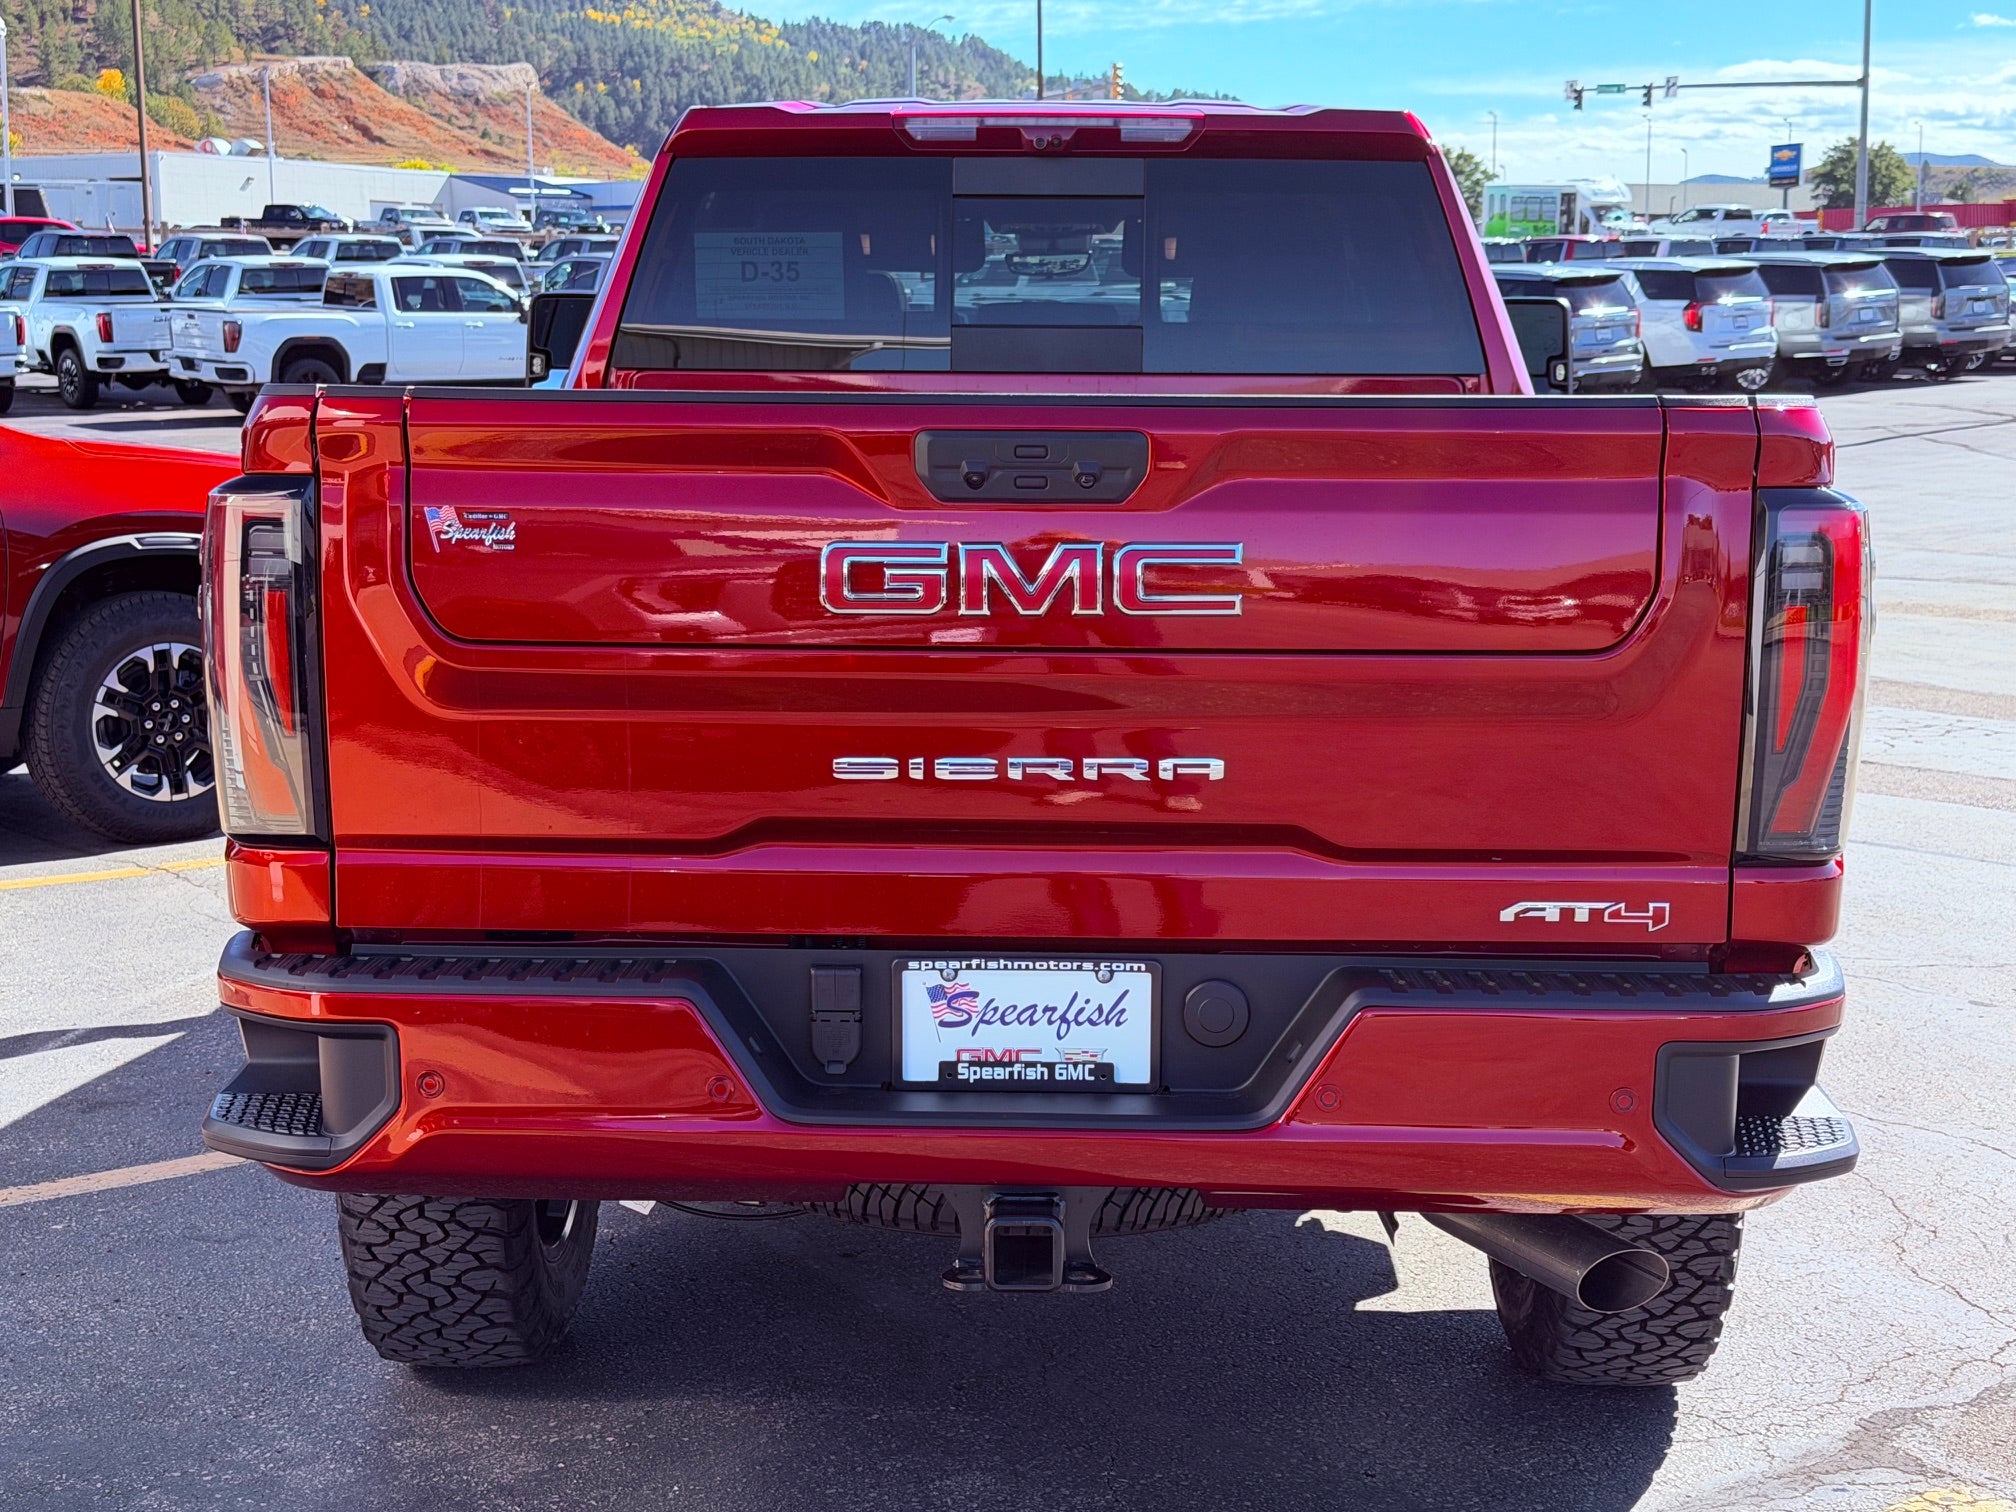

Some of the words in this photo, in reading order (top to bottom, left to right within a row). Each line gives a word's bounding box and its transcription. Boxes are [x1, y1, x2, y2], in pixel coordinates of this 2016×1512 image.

[730, 247, 768, 256] VEHICLE
[772, 247, 808, 256] DEALER
[734, 236, 765, 245] SOUTH
[767, 236, 806, 245] DAKOTA
[740, 260, 800, 283] D-35
[440, 519, 516, 546] Spearfish
[819, 541, 1244, 616] GMC
[832, 756, 1226, 781] SIERRA
[1499, 901, 1671, 932] AT4
[907, 958, 1146, 972] spearfishmotors.com
[937, 988, 1131, 1041] Spearfish
[955, 1047, 1042, 1062] GMC
[957, 1062, 1049, 1083] Spearfish
[1054, 1063, 1096, 1081] GMC
